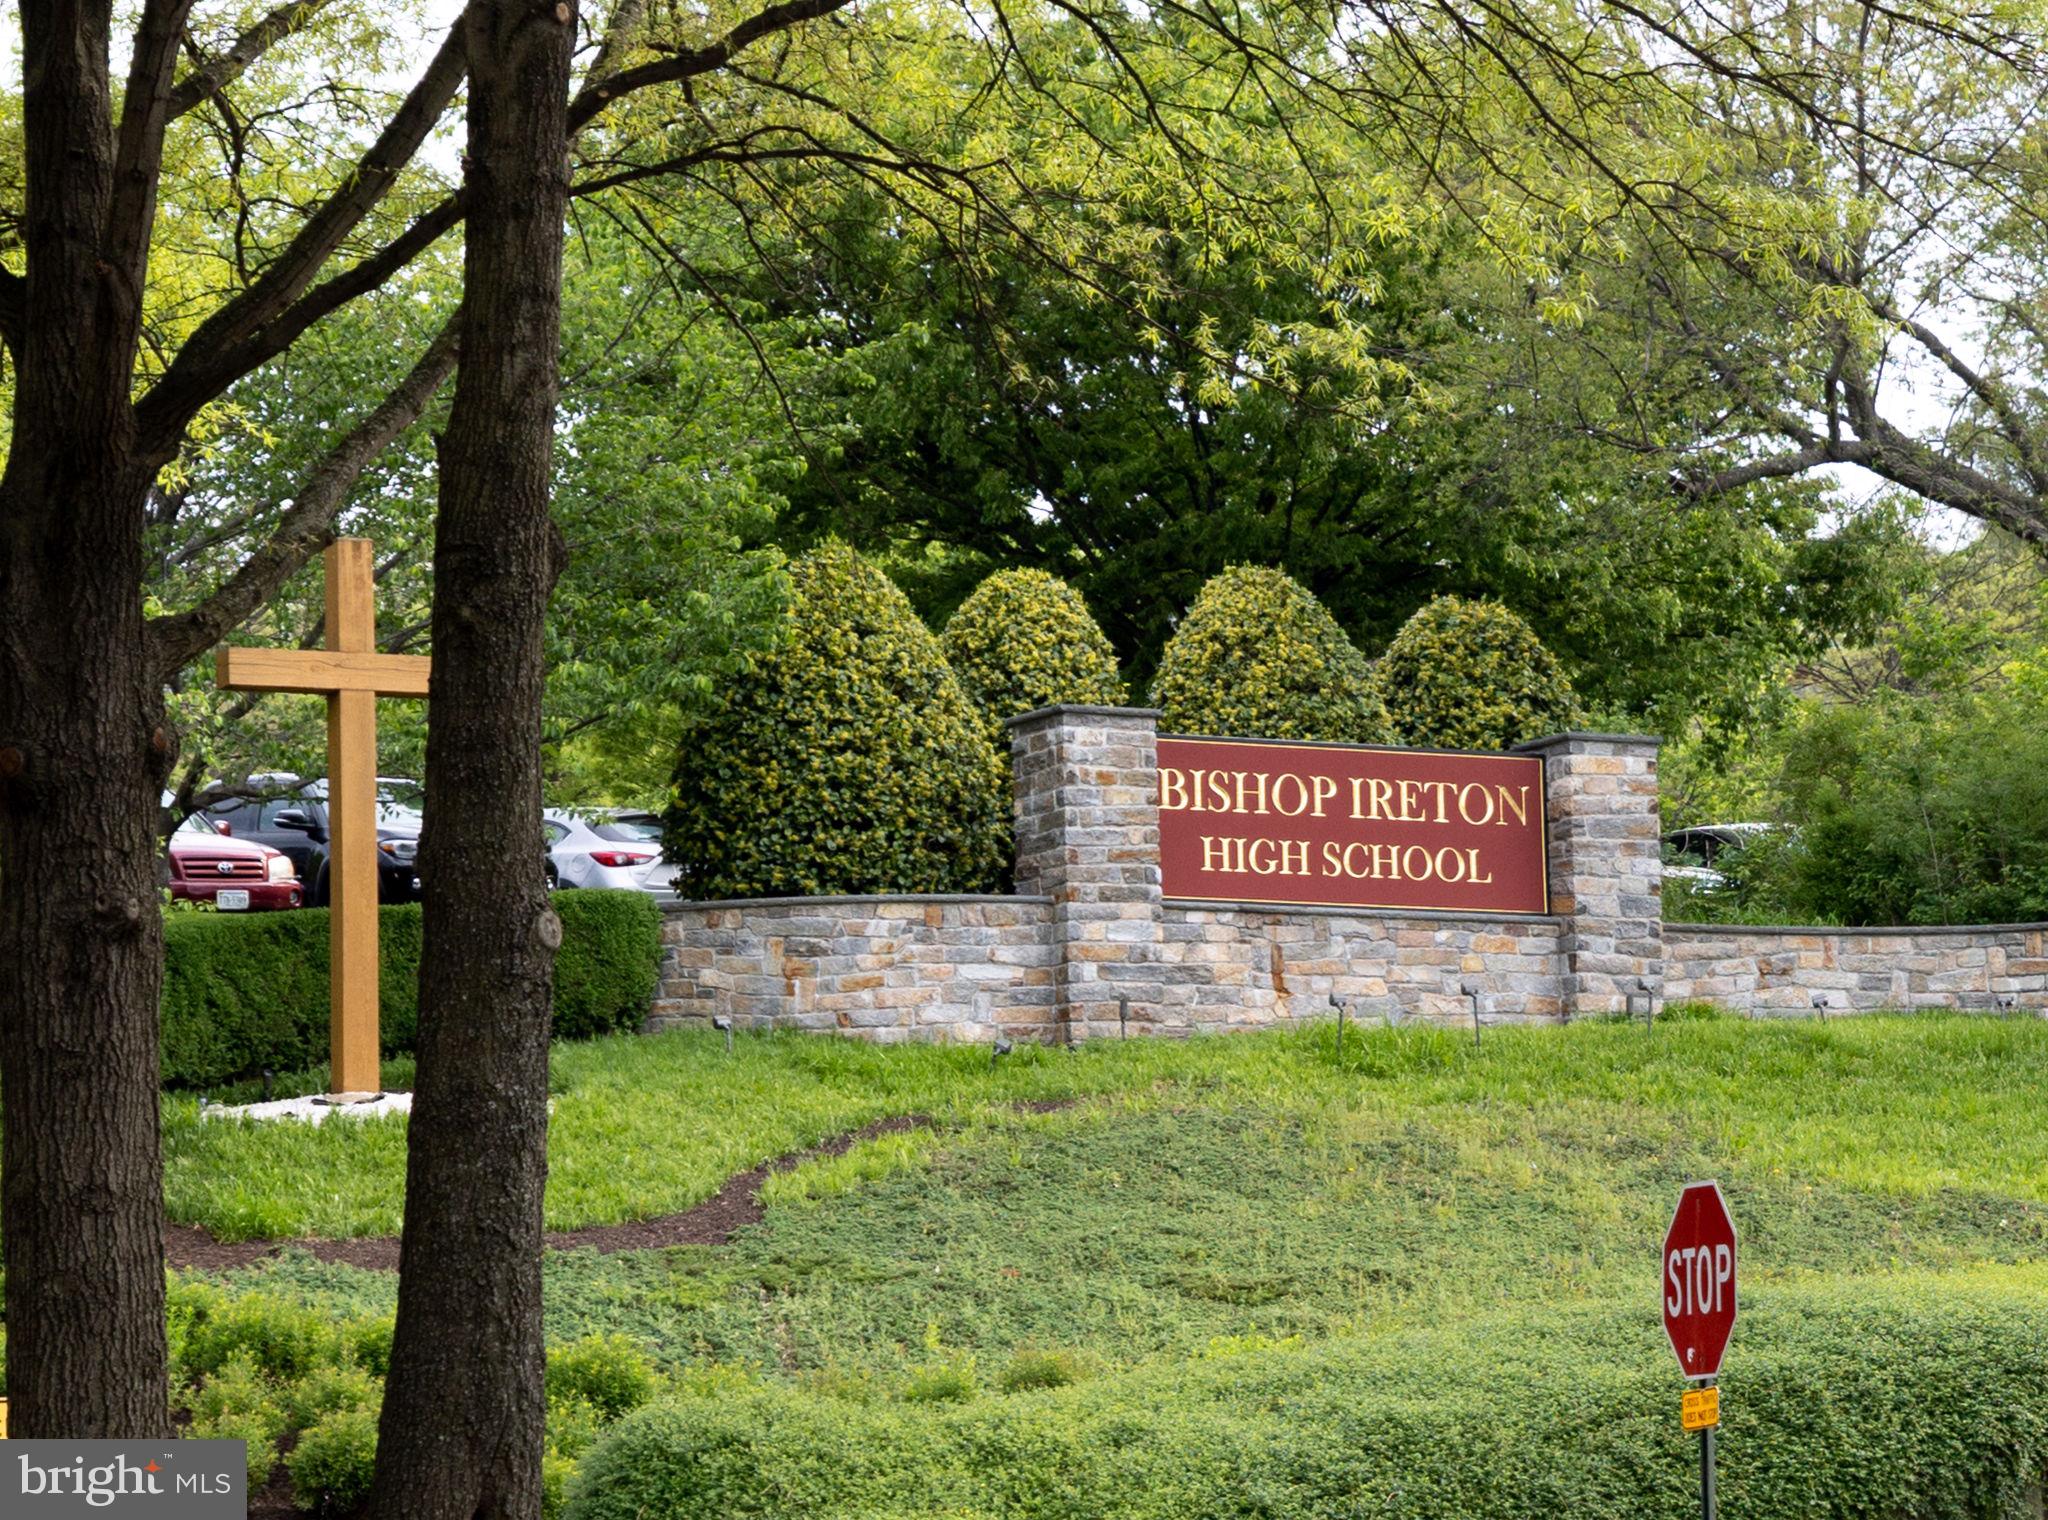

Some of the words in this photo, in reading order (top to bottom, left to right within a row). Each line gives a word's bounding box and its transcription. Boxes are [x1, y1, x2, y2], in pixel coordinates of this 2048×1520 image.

[1157, 768, 1336, 817] BISHOP
[1349, 777, 1529, 826] IRETON
[1200, 836, 1311, 876] HIGH
[1322, 841, 1492, 884] SCHOOL
[1667, 1244, 1731, 1318] STOP
